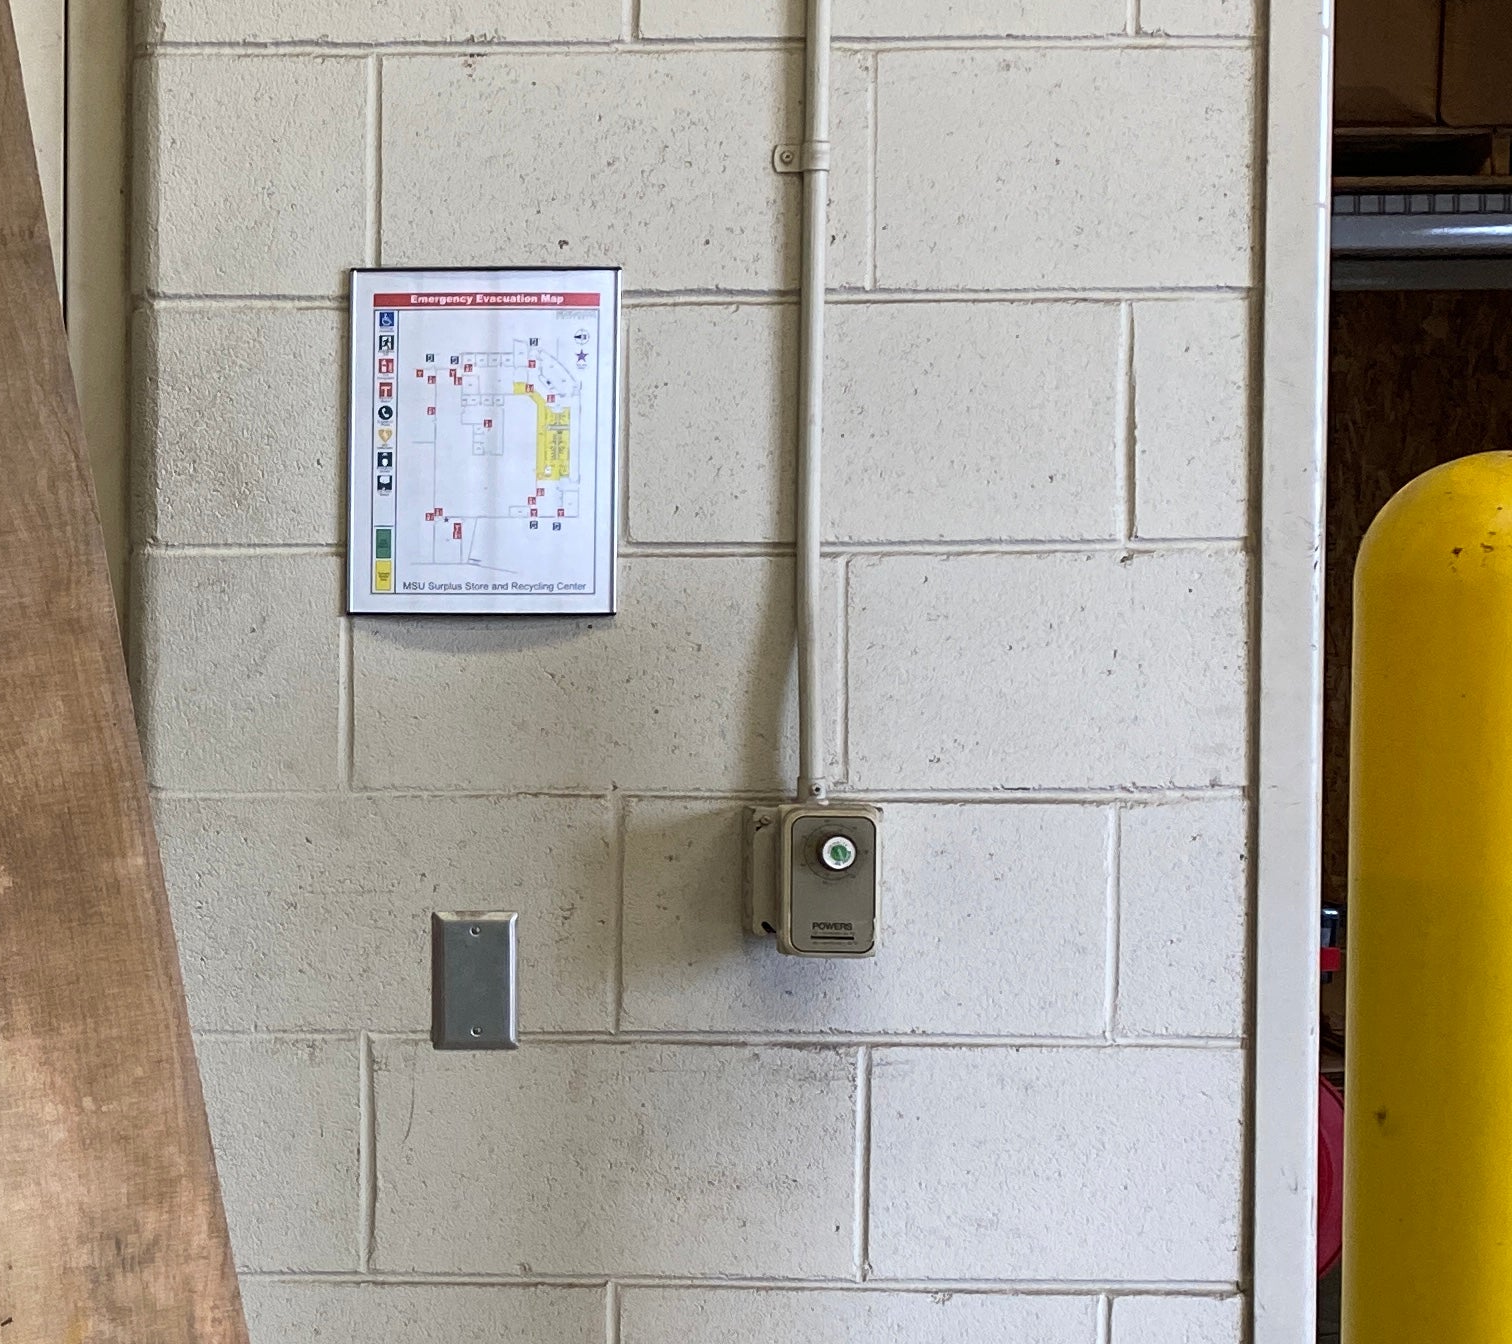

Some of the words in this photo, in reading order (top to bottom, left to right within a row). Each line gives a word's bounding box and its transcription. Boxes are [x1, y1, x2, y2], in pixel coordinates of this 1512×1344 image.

[410, 294, 473, 305] Emergency
[475, 294, 538, 304] Evacuation
[540, 294, 564, 305] Map
[402, 581, 425, 591] MSU
[427, 581, 463, 592] Surplus
[464, 581, 488, 591] Store
[491, 581, 509, 591] and
[511, 581, 554, 592] Recycling
[556, 581, 586, 591] Center
[812, 922, 853, 931] POWERS
